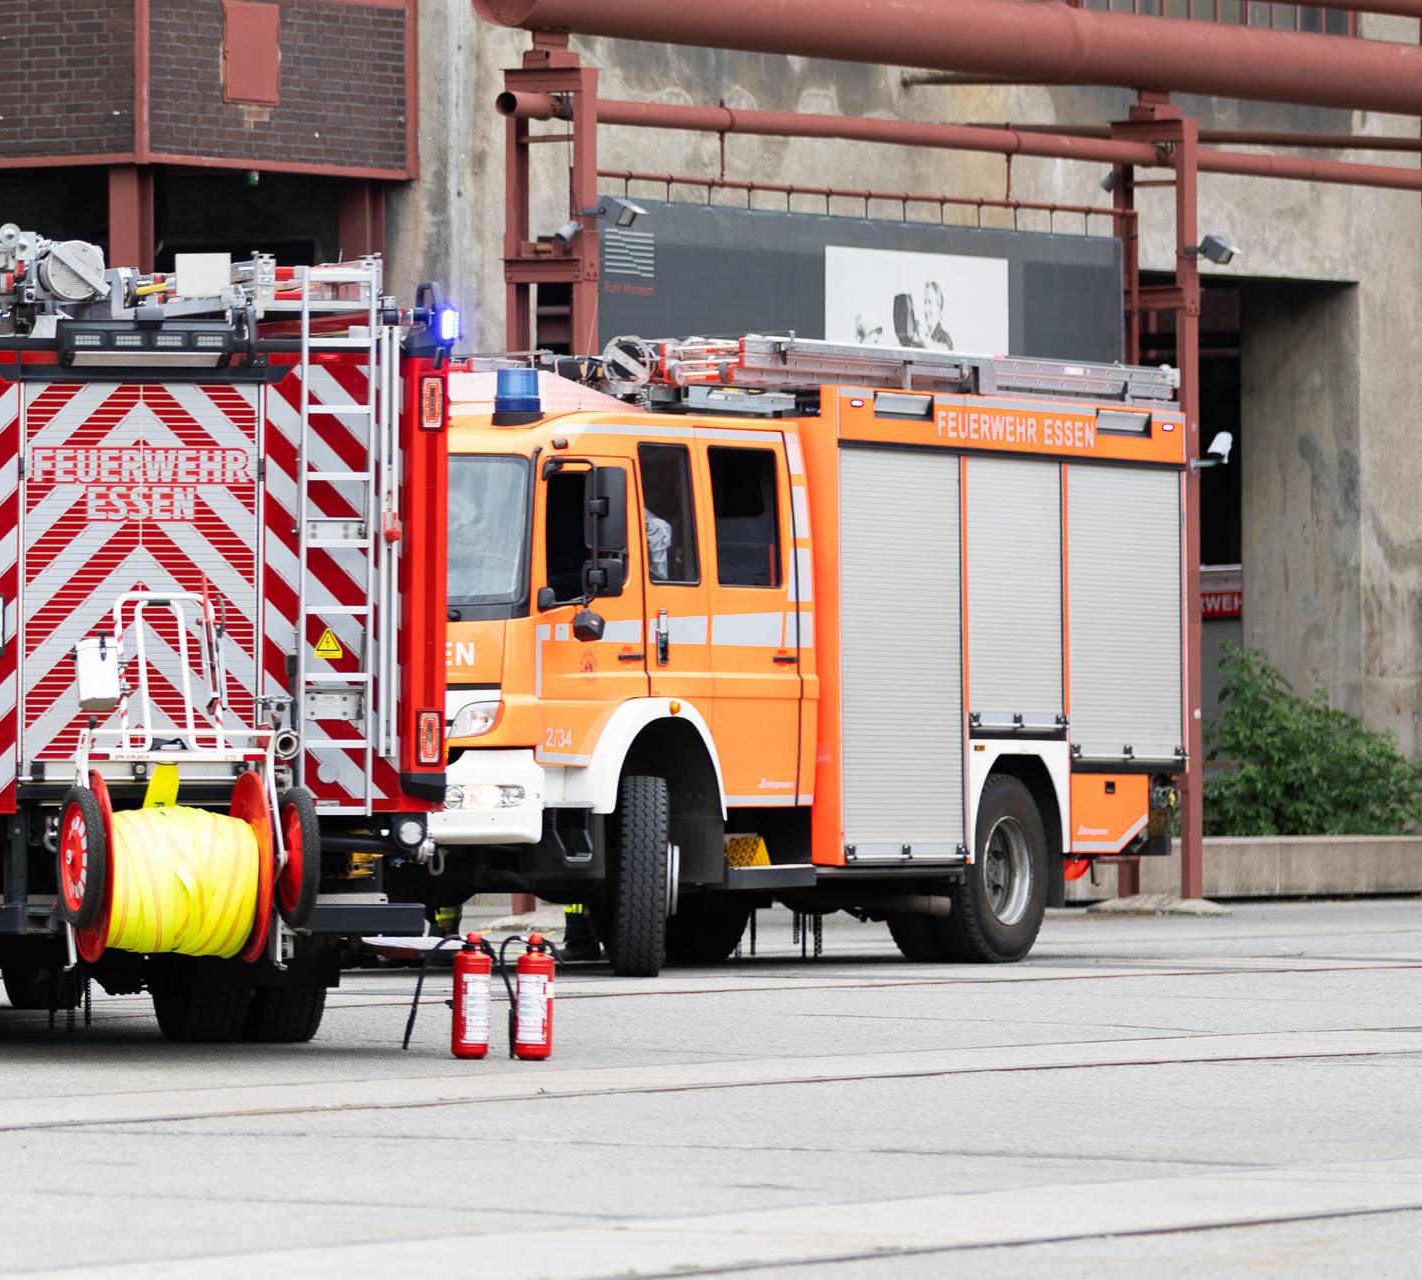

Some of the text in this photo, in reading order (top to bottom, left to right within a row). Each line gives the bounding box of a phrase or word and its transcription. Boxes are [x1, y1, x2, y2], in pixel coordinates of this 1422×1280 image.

[937, 411, 1095, 448] FEUERWEHR ESSEN
[33, 449, 250, 483] FEUERWEHR
[87, 486, 195, 521] ESSEN
[545, 727, 572, 748] 2/34
